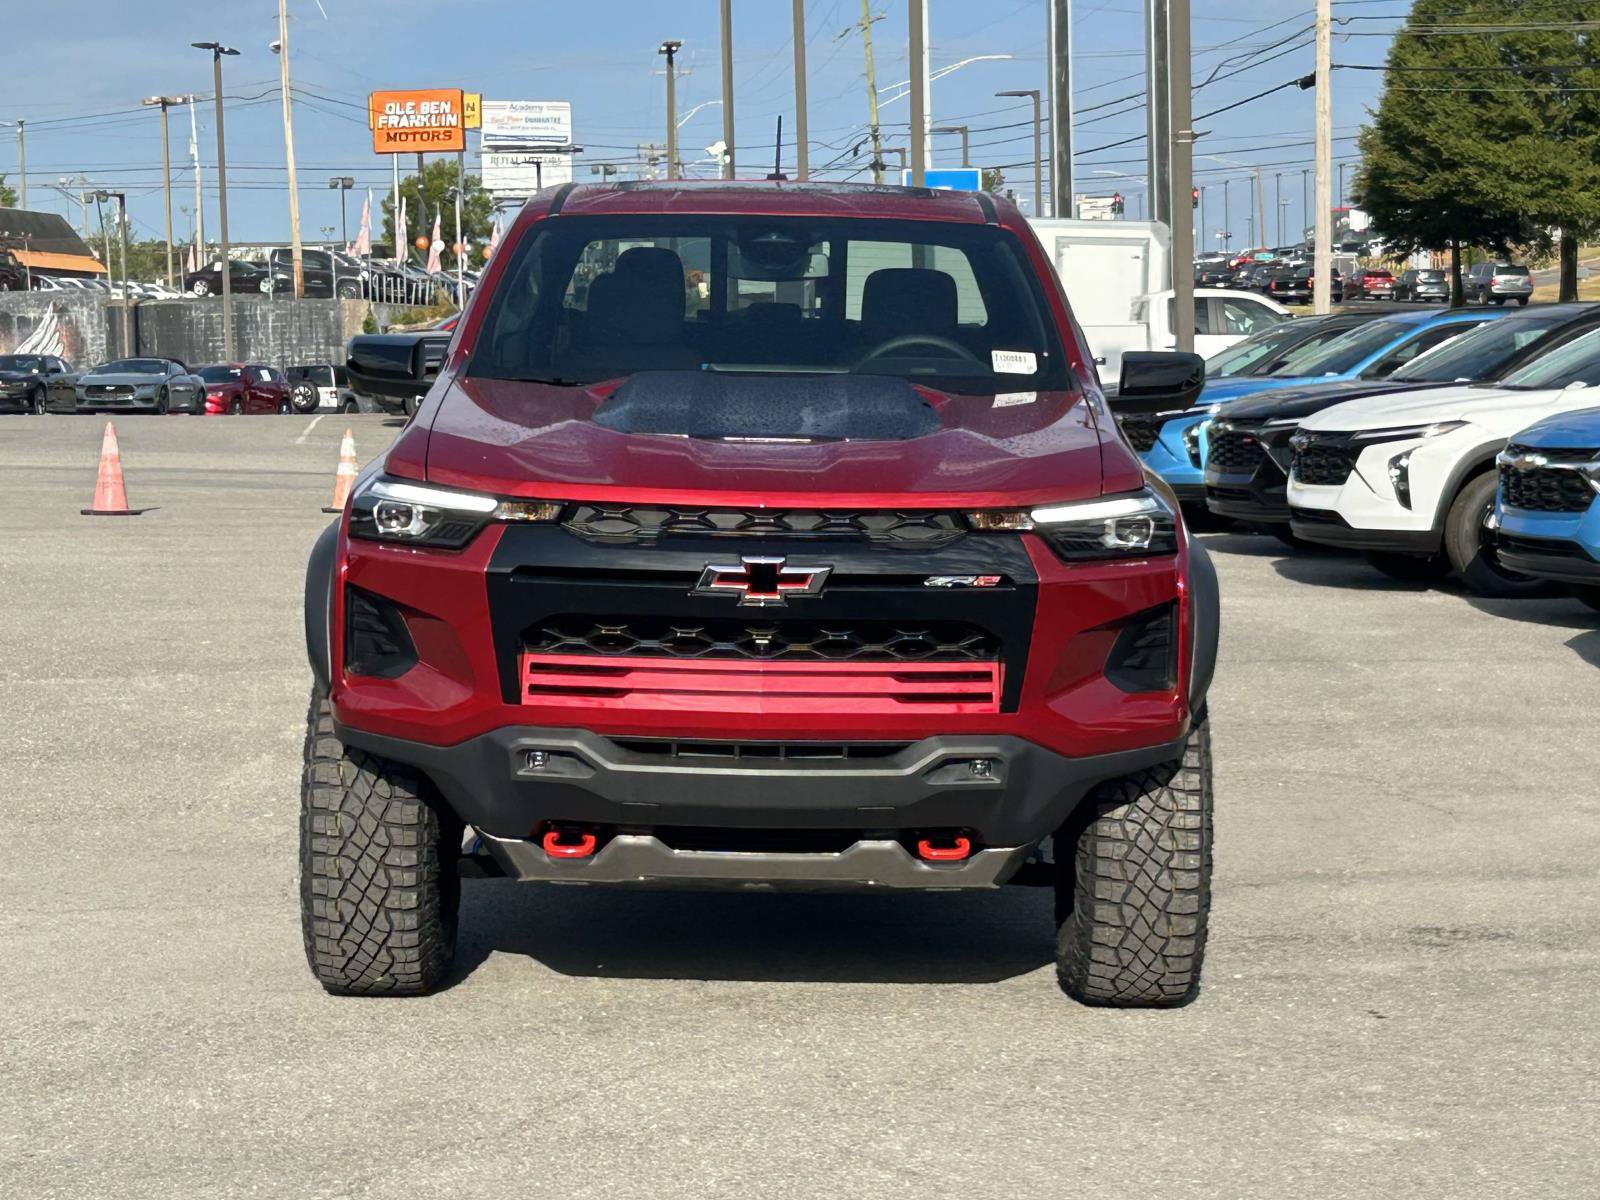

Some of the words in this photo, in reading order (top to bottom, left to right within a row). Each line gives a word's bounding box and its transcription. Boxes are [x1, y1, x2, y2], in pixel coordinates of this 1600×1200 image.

[385, 101, 416, 115] OLE
[421, 100, 451, 114] BEN
[377, 114, 458, 129] FRANKLIN
[386, 130, 453, 143] MOTORS
